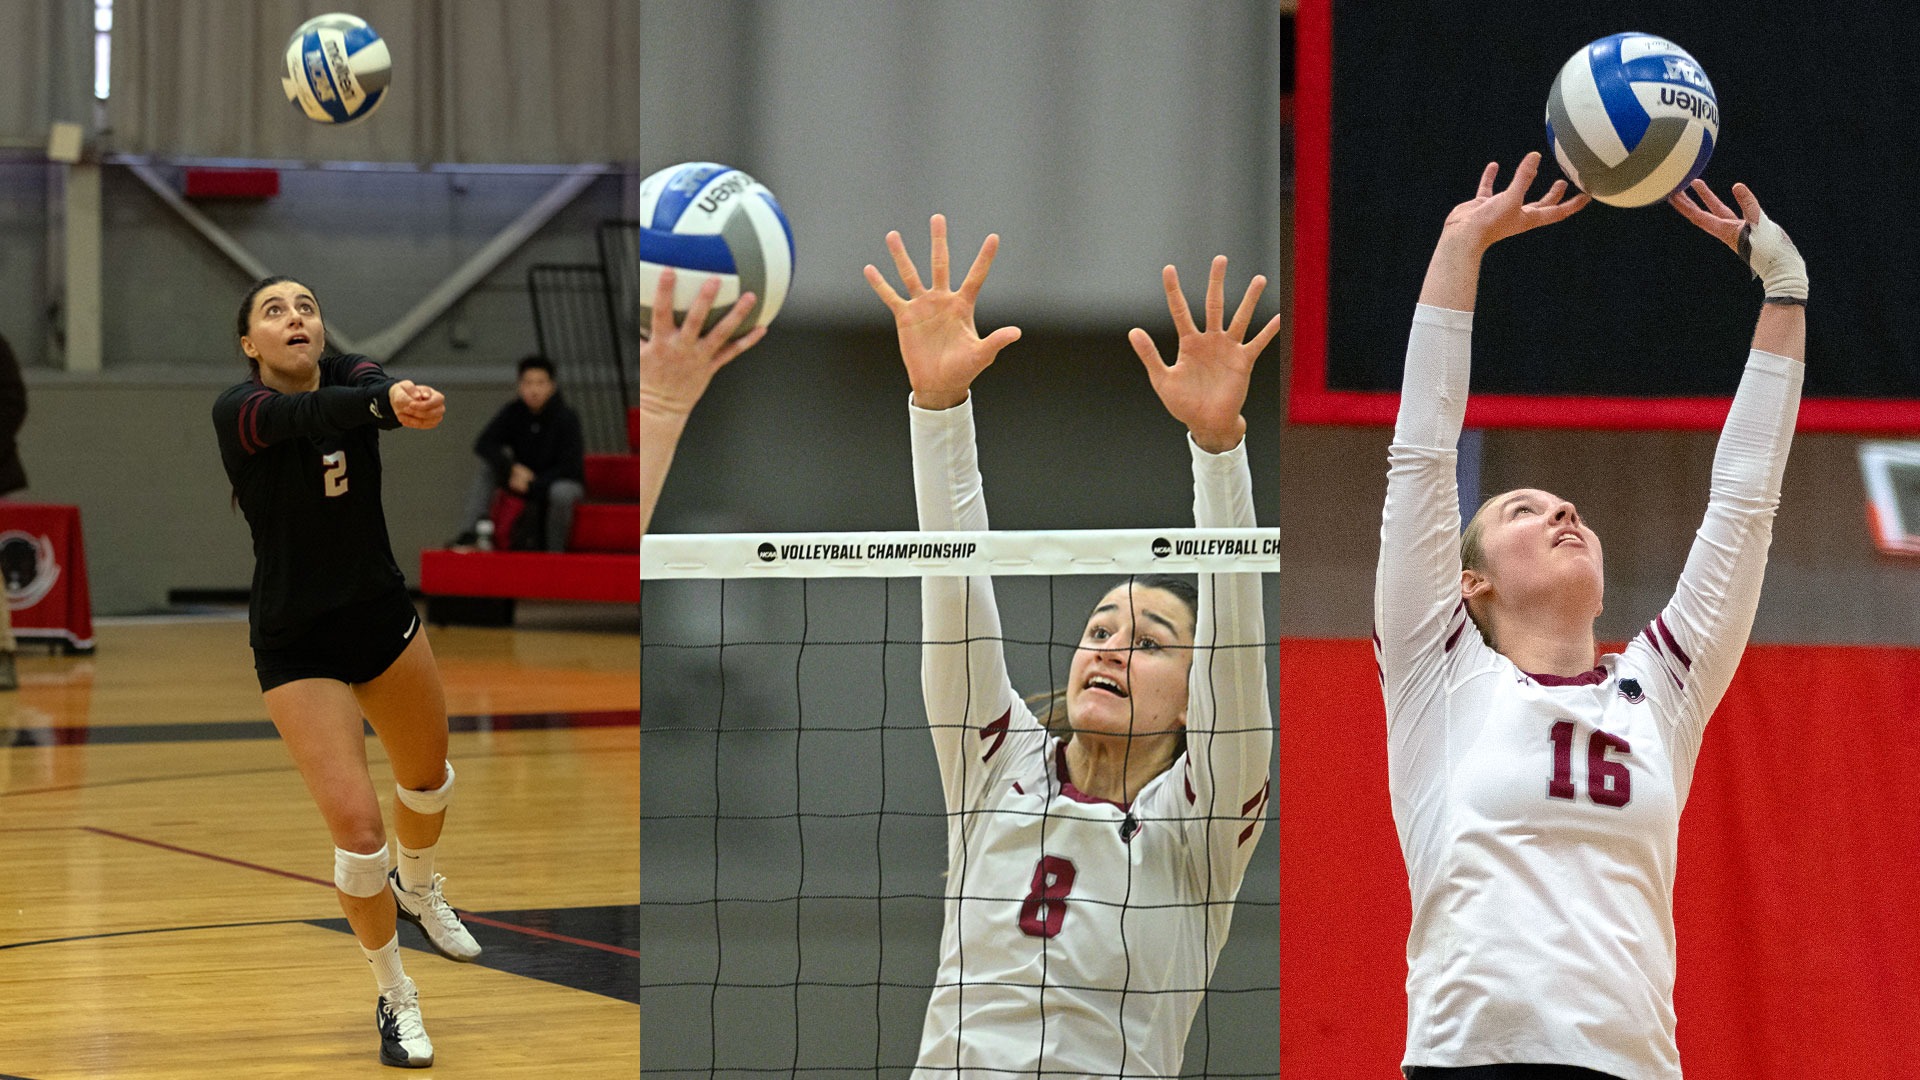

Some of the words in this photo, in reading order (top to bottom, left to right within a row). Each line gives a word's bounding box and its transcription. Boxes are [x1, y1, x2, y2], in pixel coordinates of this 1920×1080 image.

[324, 39, 356, 101] molten
[323, 450, 349, 497] 2
[781, 544, 863, 560] VOLLEYBALL
[867, 543, 976, 559] CHAMPIONSHIP
[1175, 539, 1258, 555] VOLLEYBALL
[1546, 718, 1633, 809] 16
[1016, 852, 1078, 940] 8
